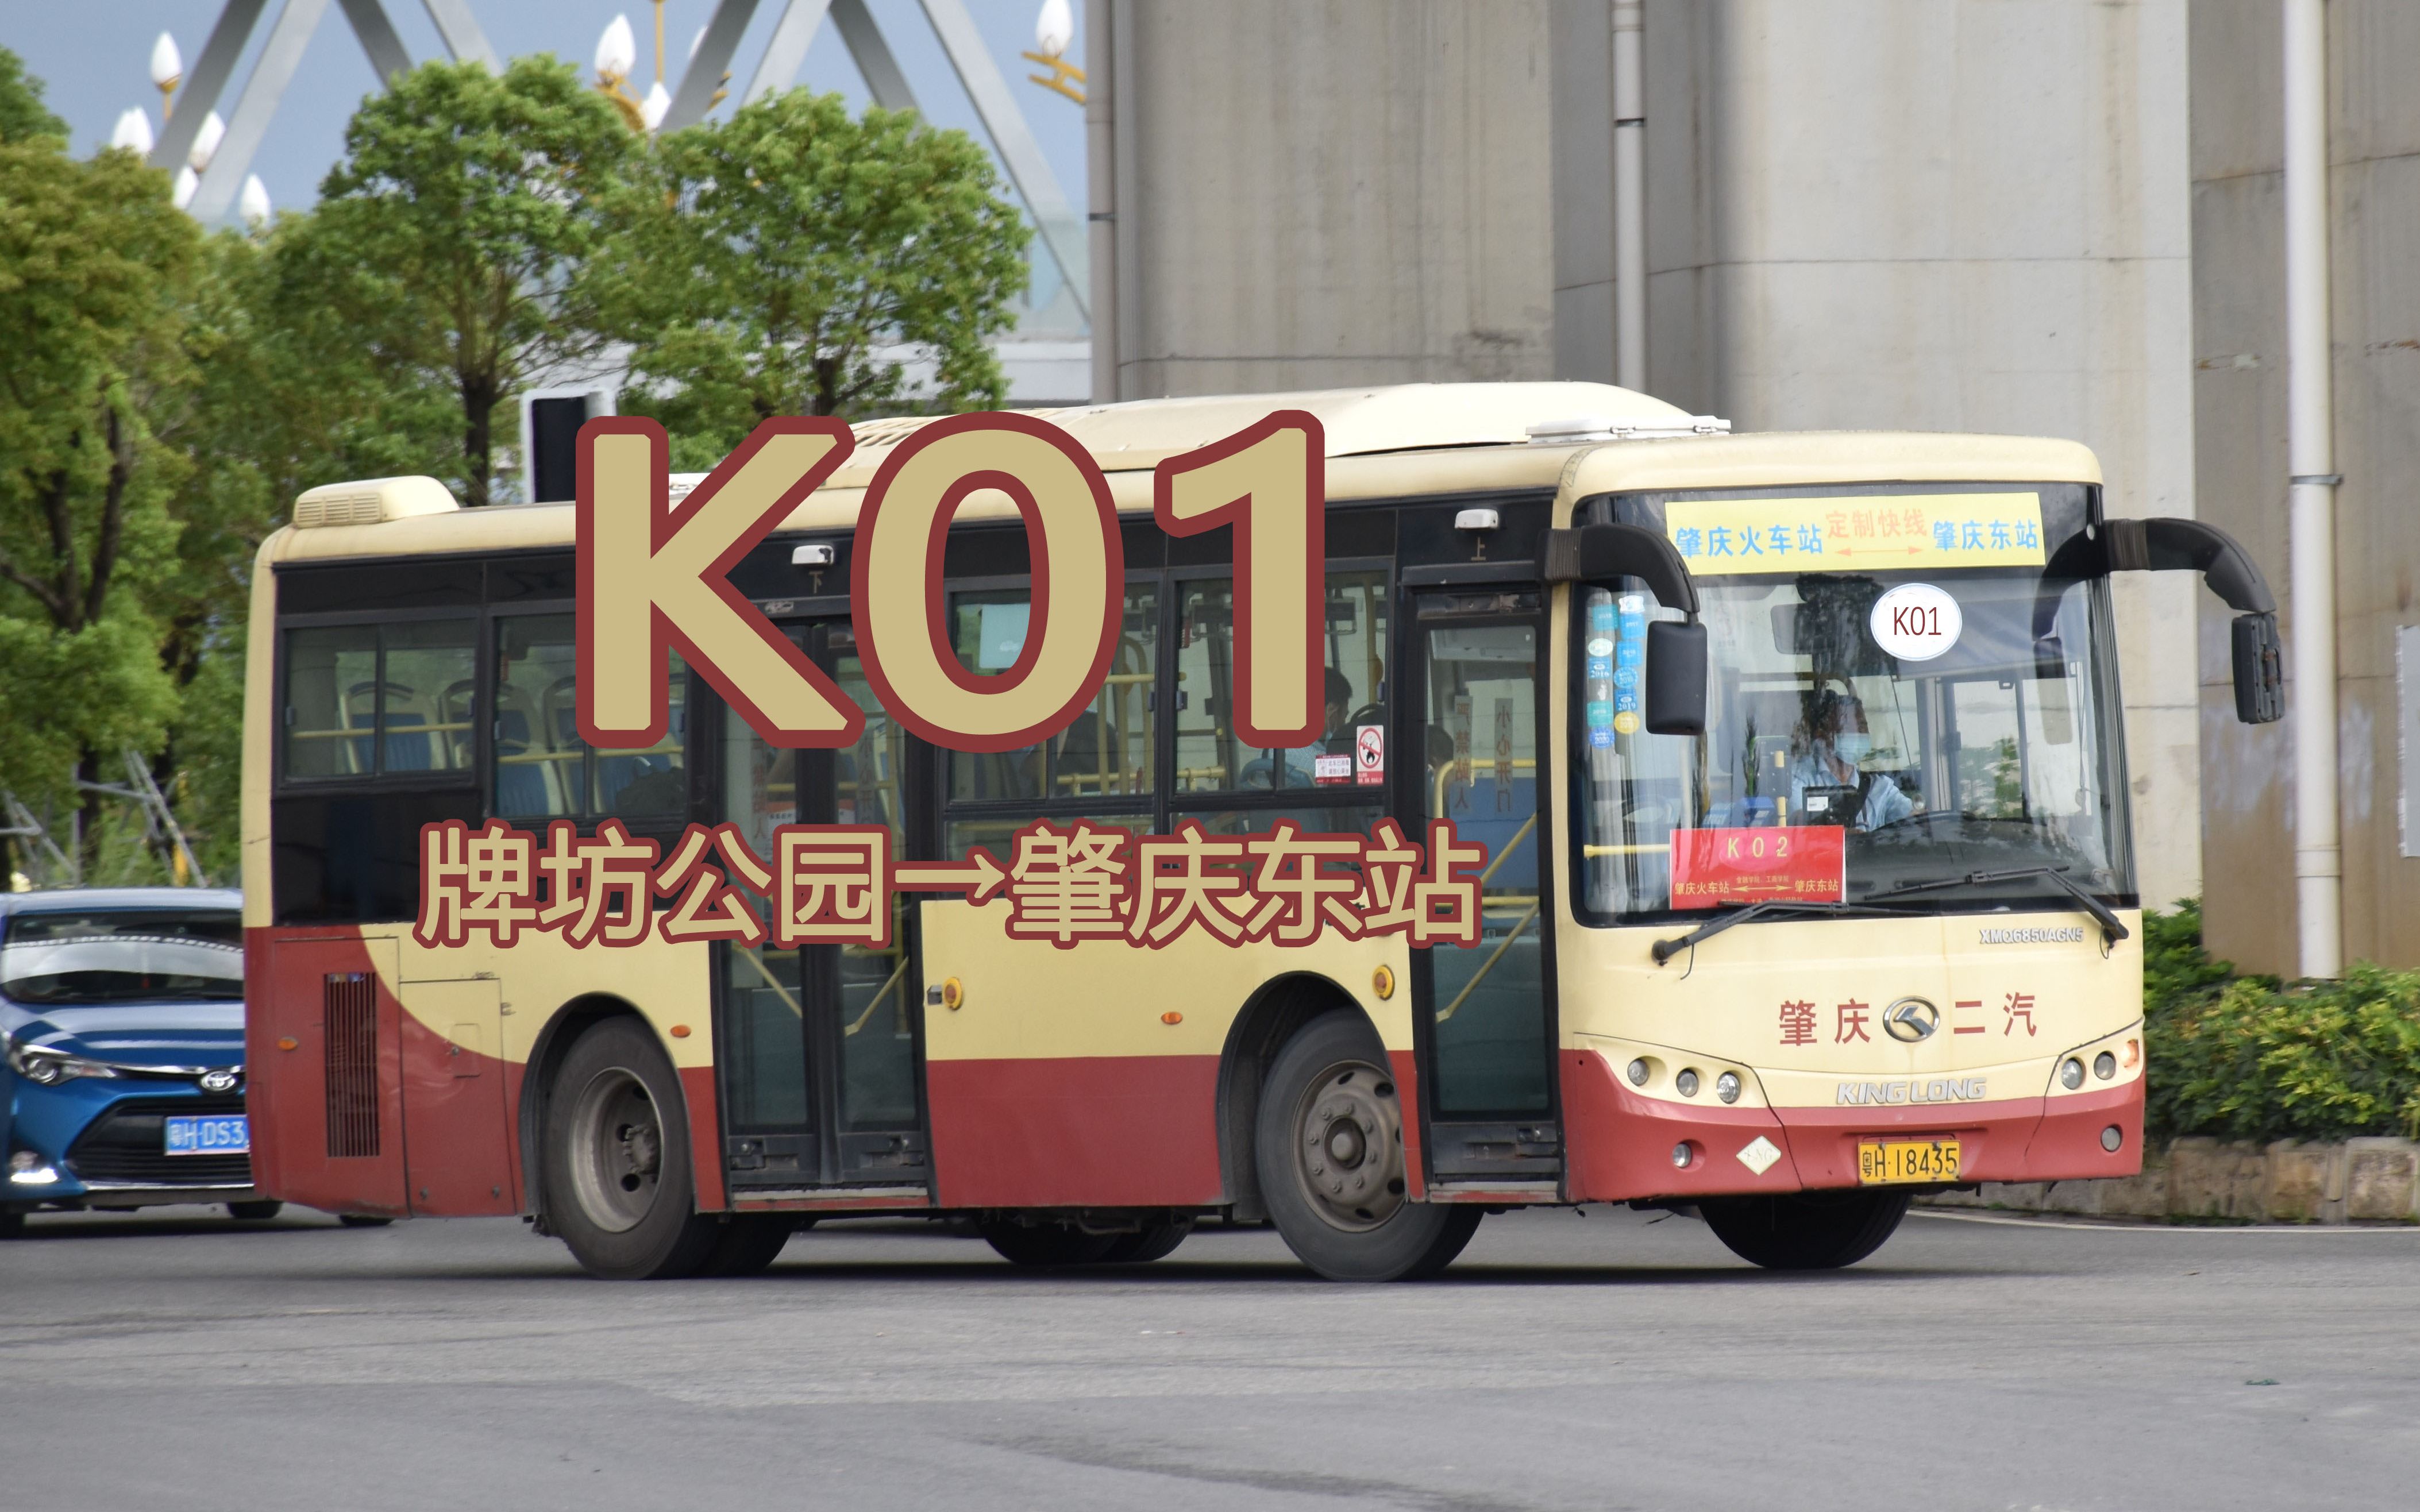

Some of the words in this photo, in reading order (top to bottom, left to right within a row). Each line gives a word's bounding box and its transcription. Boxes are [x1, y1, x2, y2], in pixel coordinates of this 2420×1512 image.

[1826, 509, 1928, 538] 定制快线
[1933, 518, 2038, 551] 肇庆东站
[1471, 537, 1486, 561] 上
[1675, 523, 1823, 558] 肇庆火车站
[809, 570, 823, 594] 下
[1893, 606, 1942, 636] K01
[1617, 703, 1636, 711] 2019
[1675, 882, 1729, 895] 肇庆火车站
[1794, 879, 1839, 893] 肇庆东站
[1980, 927, 2084, 944] XMQ6850AGN5
